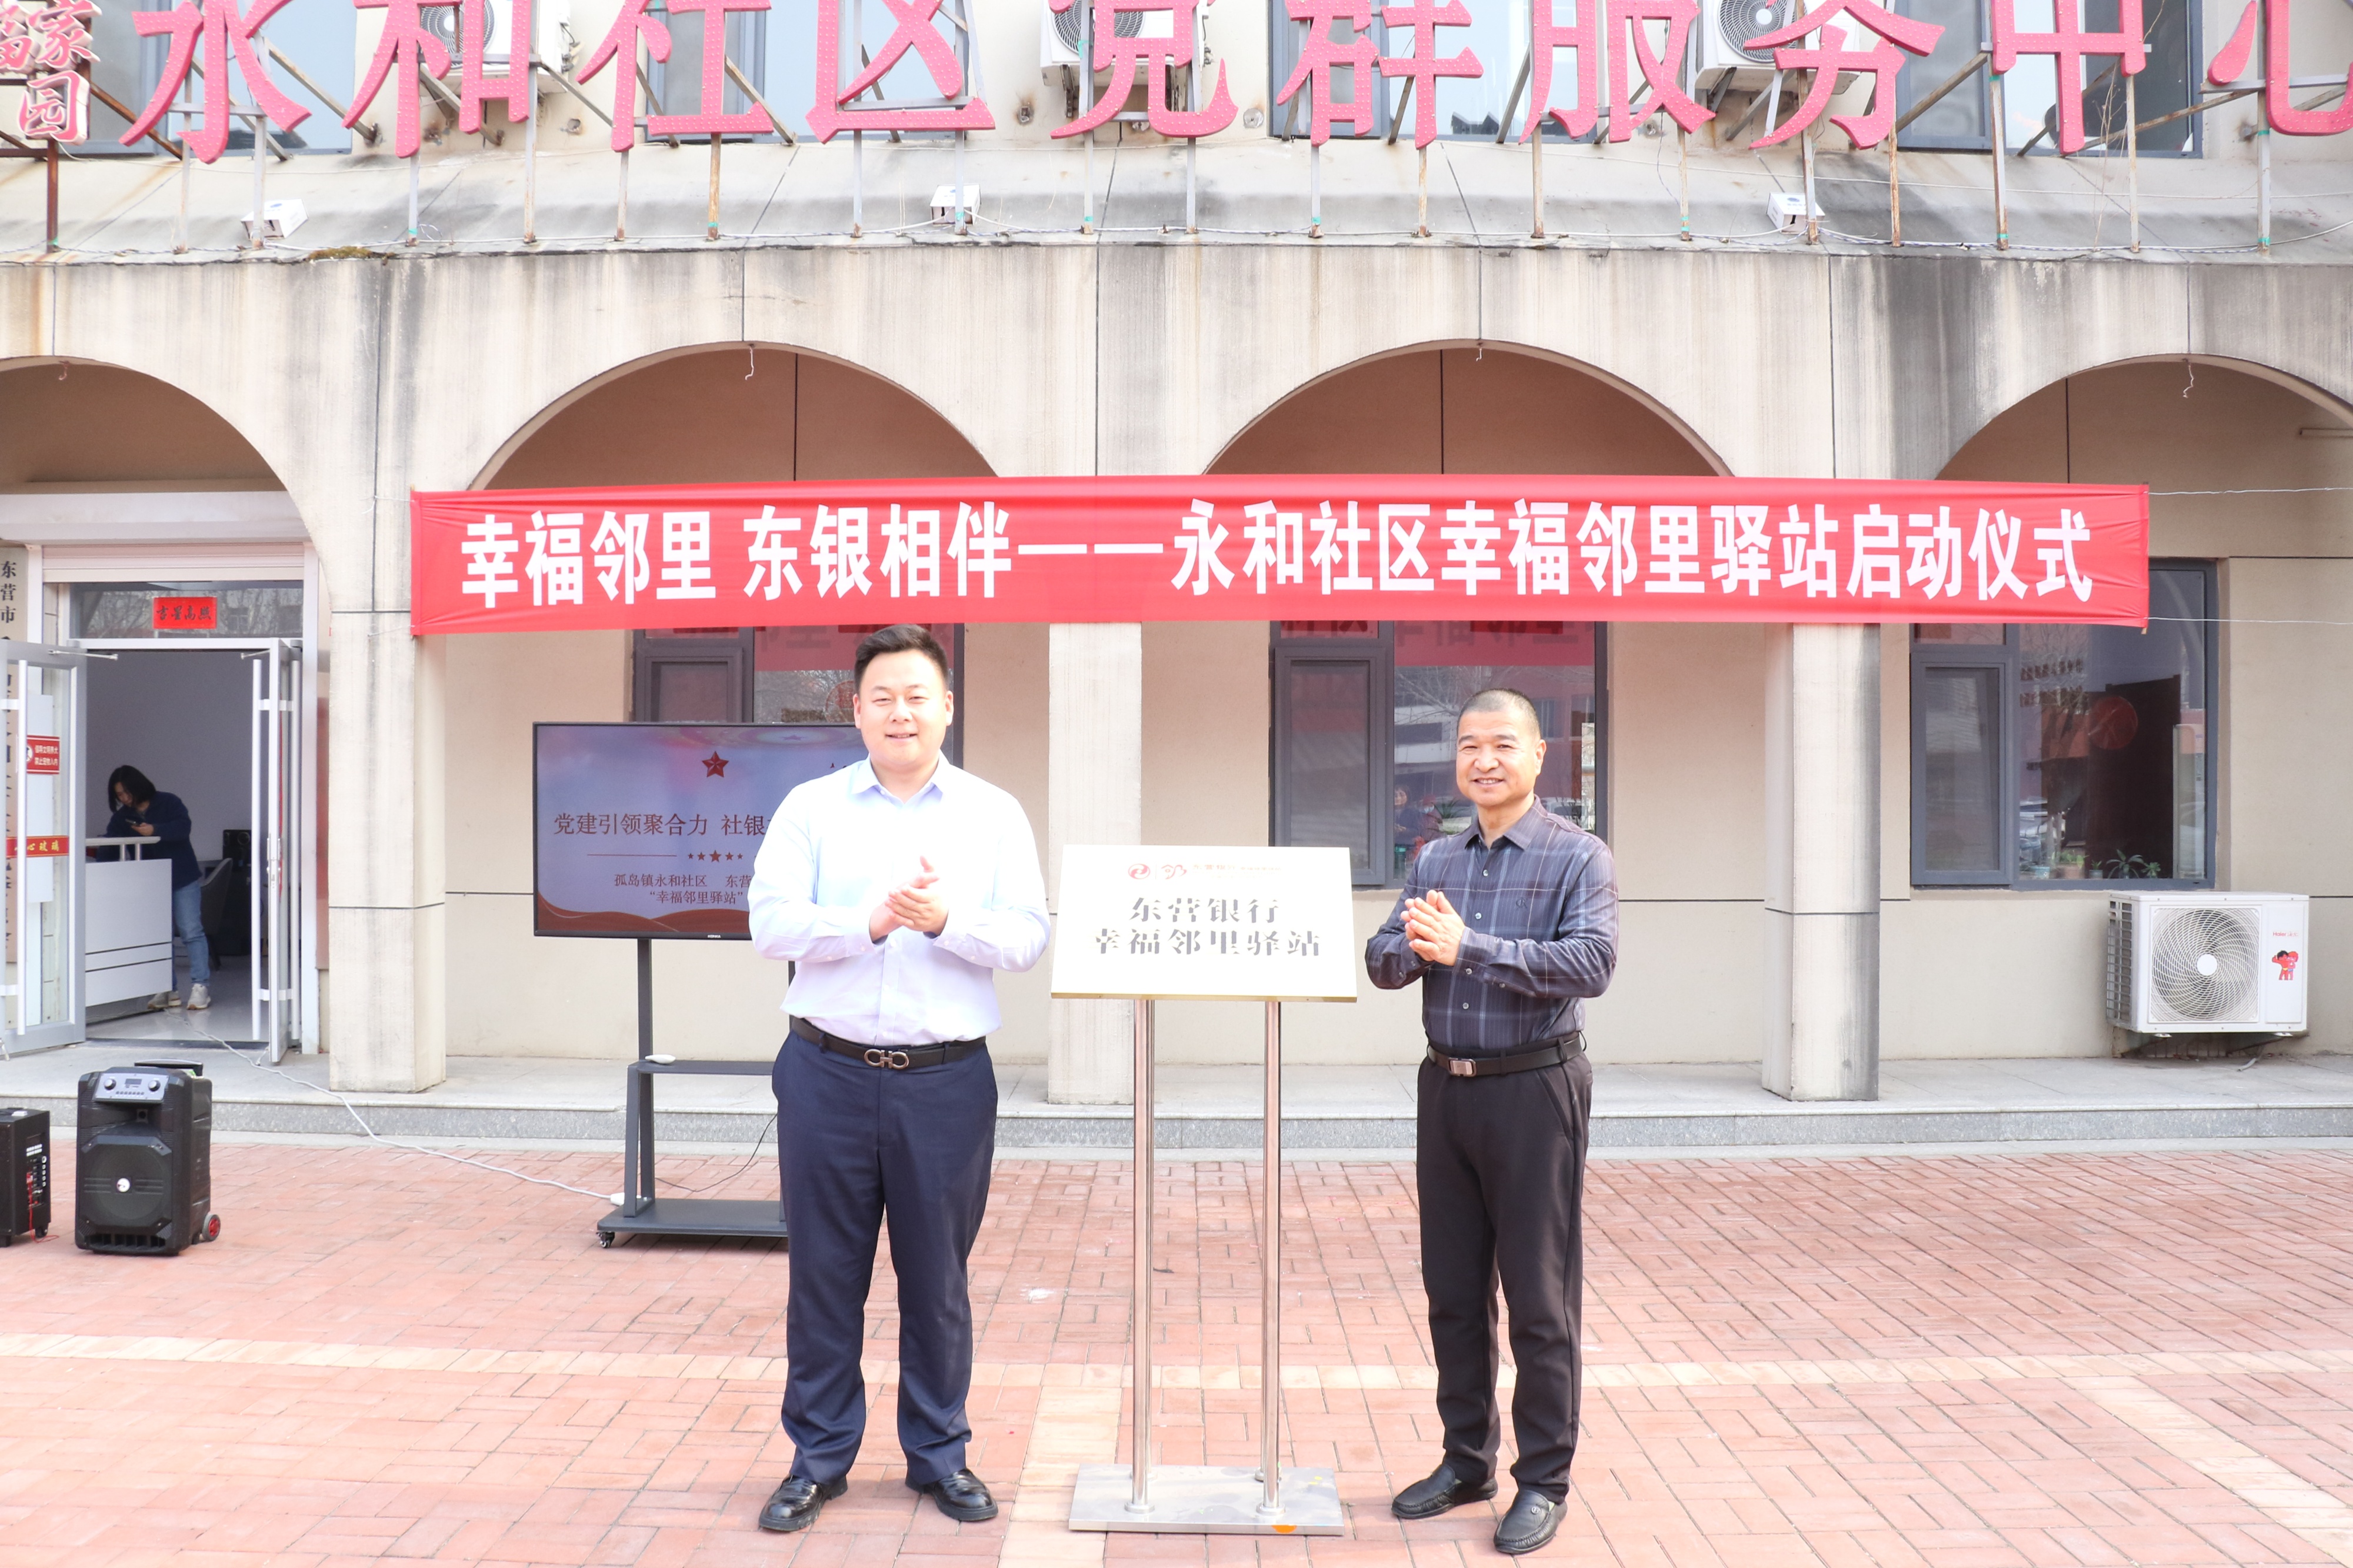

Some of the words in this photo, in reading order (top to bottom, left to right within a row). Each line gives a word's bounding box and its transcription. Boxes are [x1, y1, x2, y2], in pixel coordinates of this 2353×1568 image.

[460, 510, 716, 608] 幸福邻里
[743, 499, 2093, 602] 东银相伴——永和社区幸福邻里驿站启动仪式
[156, 605, 211, 620] 吉星高照
[554, 812, 708, 836] 党建引领聚合力
[721, 813, 771, 836] 社银
[14, 839, 59, 851] 心玻璃
[614, 873, 708, 888] 孤岛镇永和社区
[649, 890, 744, 905] “幸福邻里驿站”
[1128, 897, 1279, 923] 东营银行
[1093, 928, 1321, 957] 幸福邻里驿站
